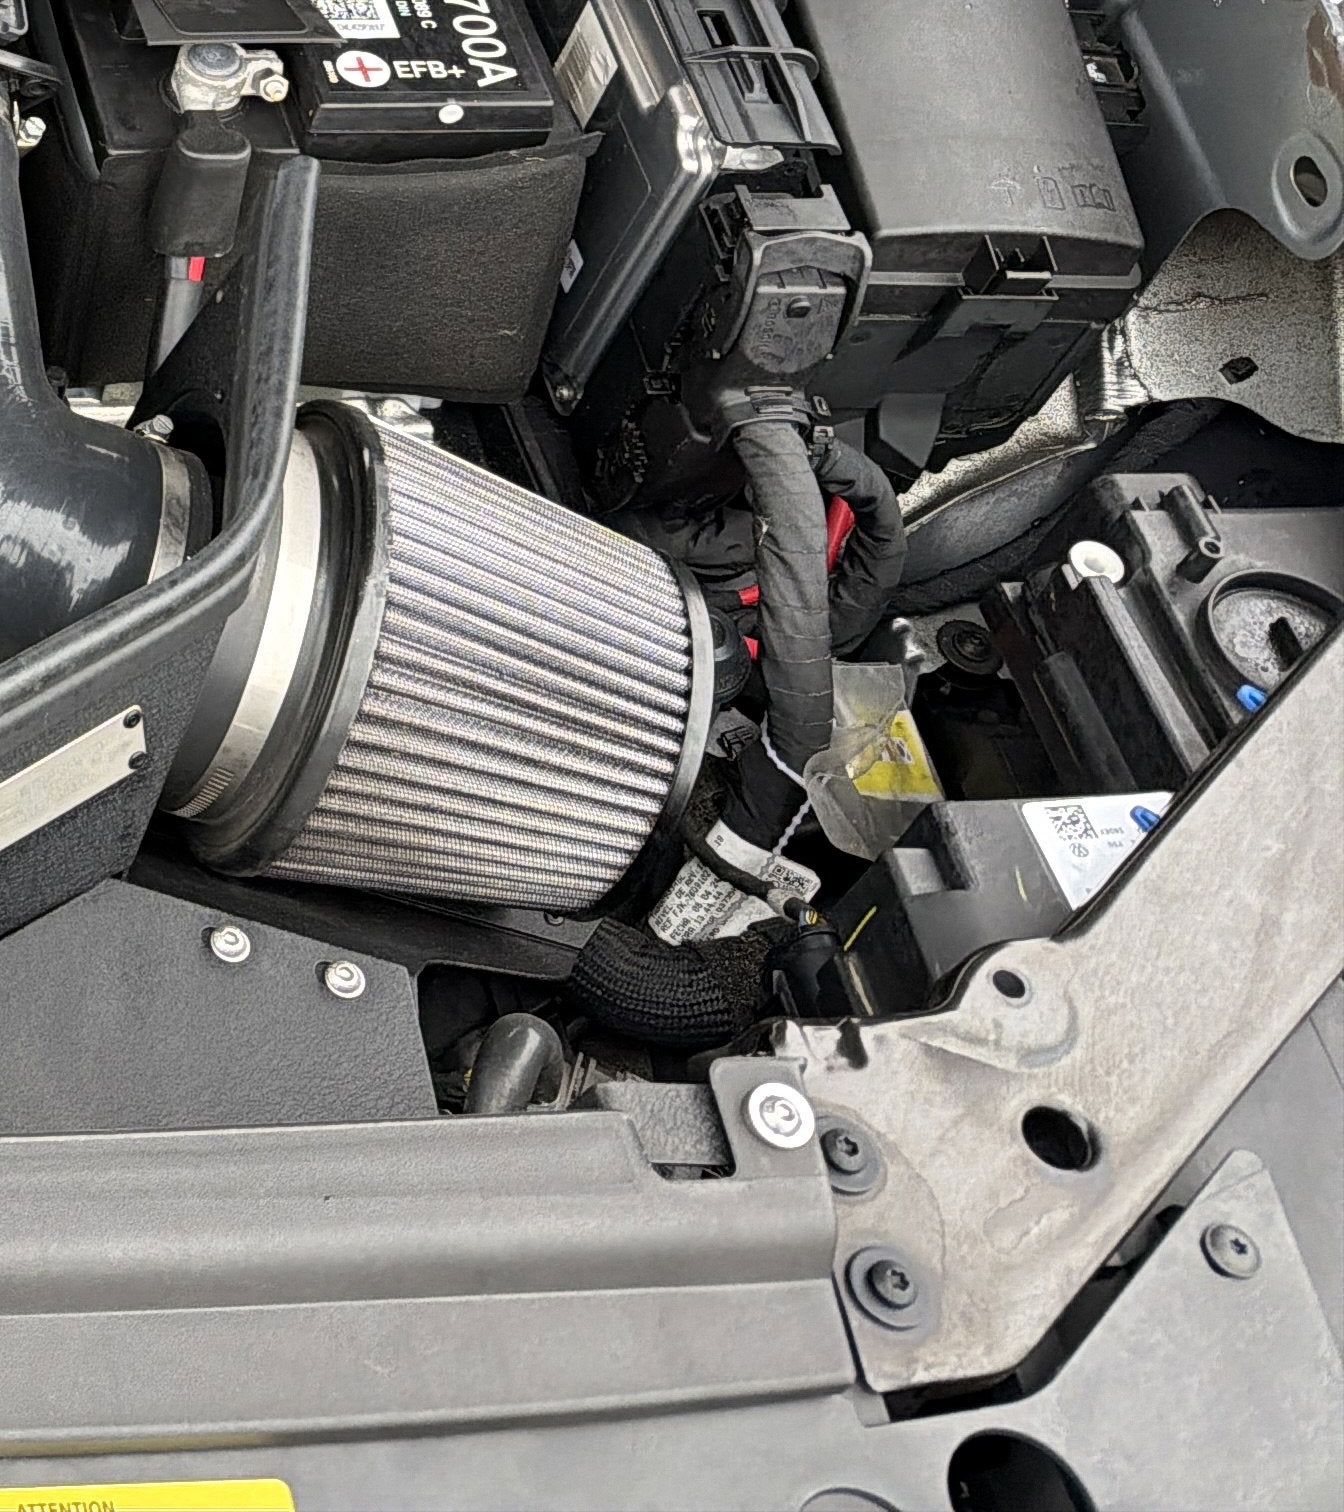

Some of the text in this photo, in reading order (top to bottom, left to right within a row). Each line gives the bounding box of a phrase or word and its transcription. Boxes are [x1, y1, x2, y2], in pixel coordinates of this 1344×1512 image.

[394, 0, 412, 17] DIN
[420, 20, 438, 29] C
[392, 60, 466, 79] EFB+
